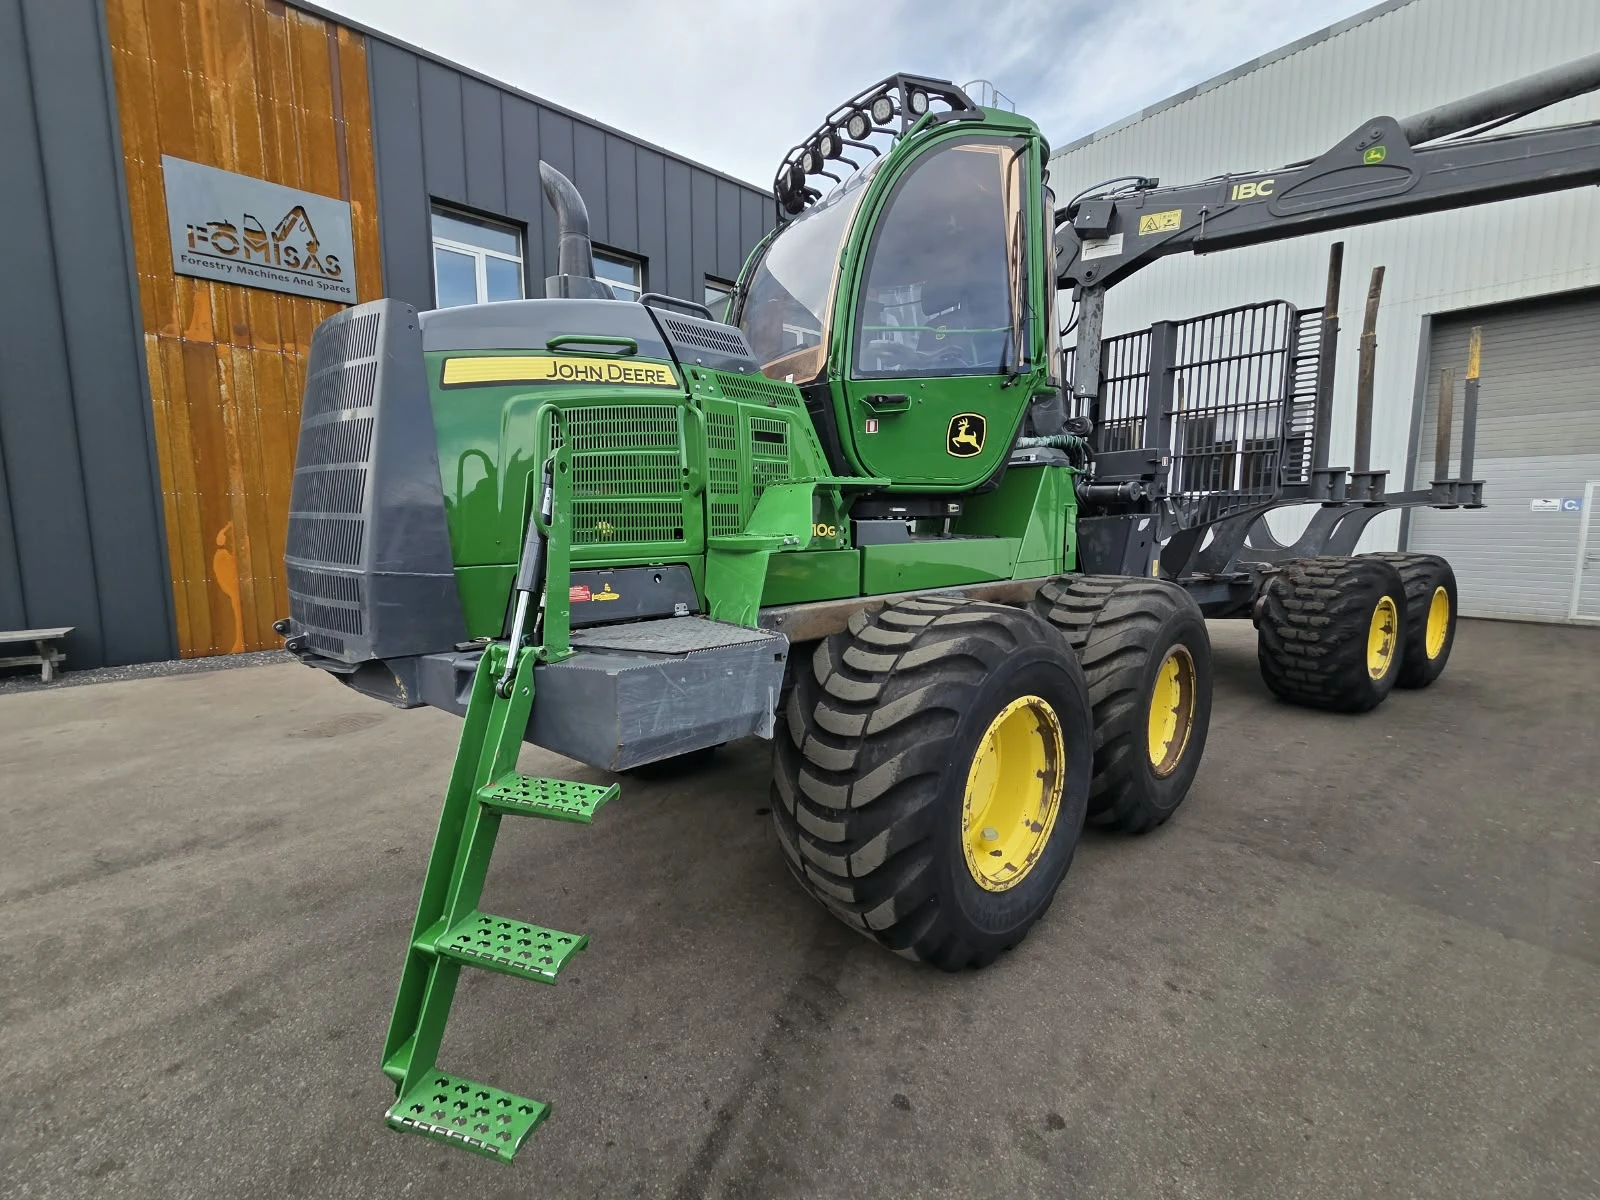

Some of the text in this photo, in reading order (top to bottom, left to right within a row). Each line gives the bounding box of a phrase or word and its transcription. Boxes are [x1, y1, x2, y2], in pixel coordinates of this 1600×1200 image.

[1231, 179, 1275, 201] IBC
[180, 254, 351, 294] Forestry Machines And Spares
[546, 361, 666, 383] JOHN DEERE
